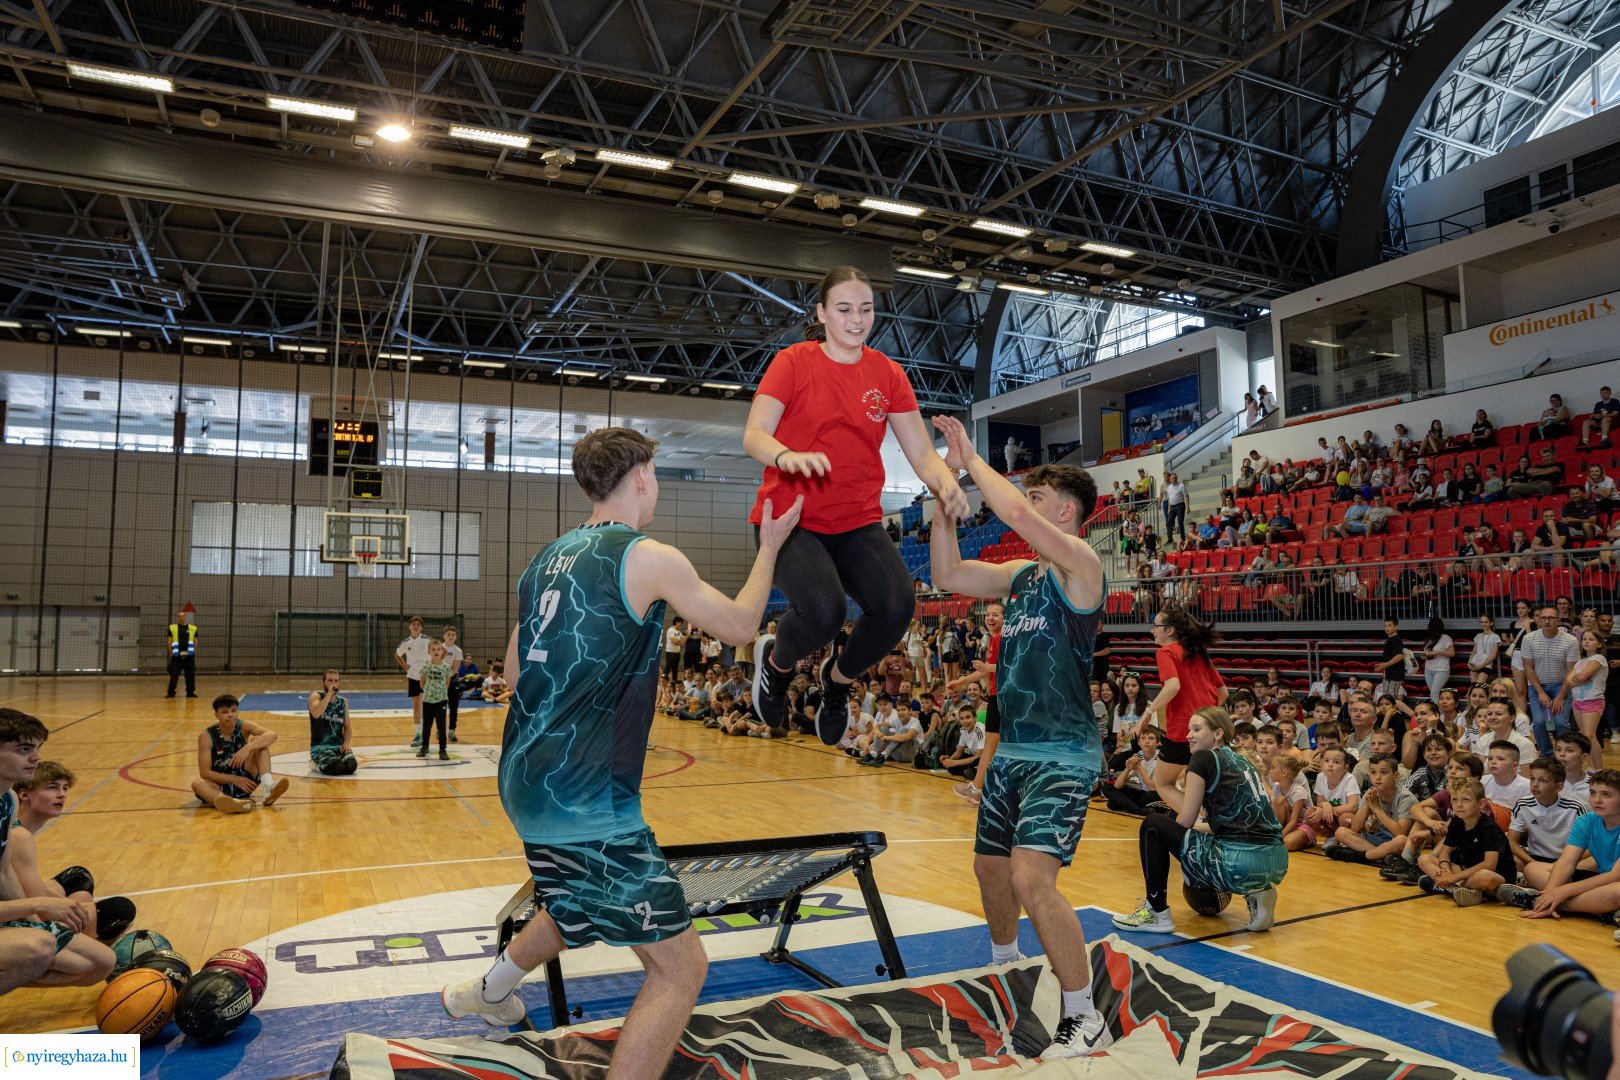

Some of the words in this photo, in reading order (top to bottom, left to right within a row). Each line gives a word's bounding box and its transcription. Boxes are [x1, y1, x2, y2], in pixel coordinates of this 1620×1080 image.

[1489, 302, 1595, 347] Continental
[525, 589, 561, 663] 2
[1243, 770, 1271, 803] 14
[634, 901, 659, 932] 2
